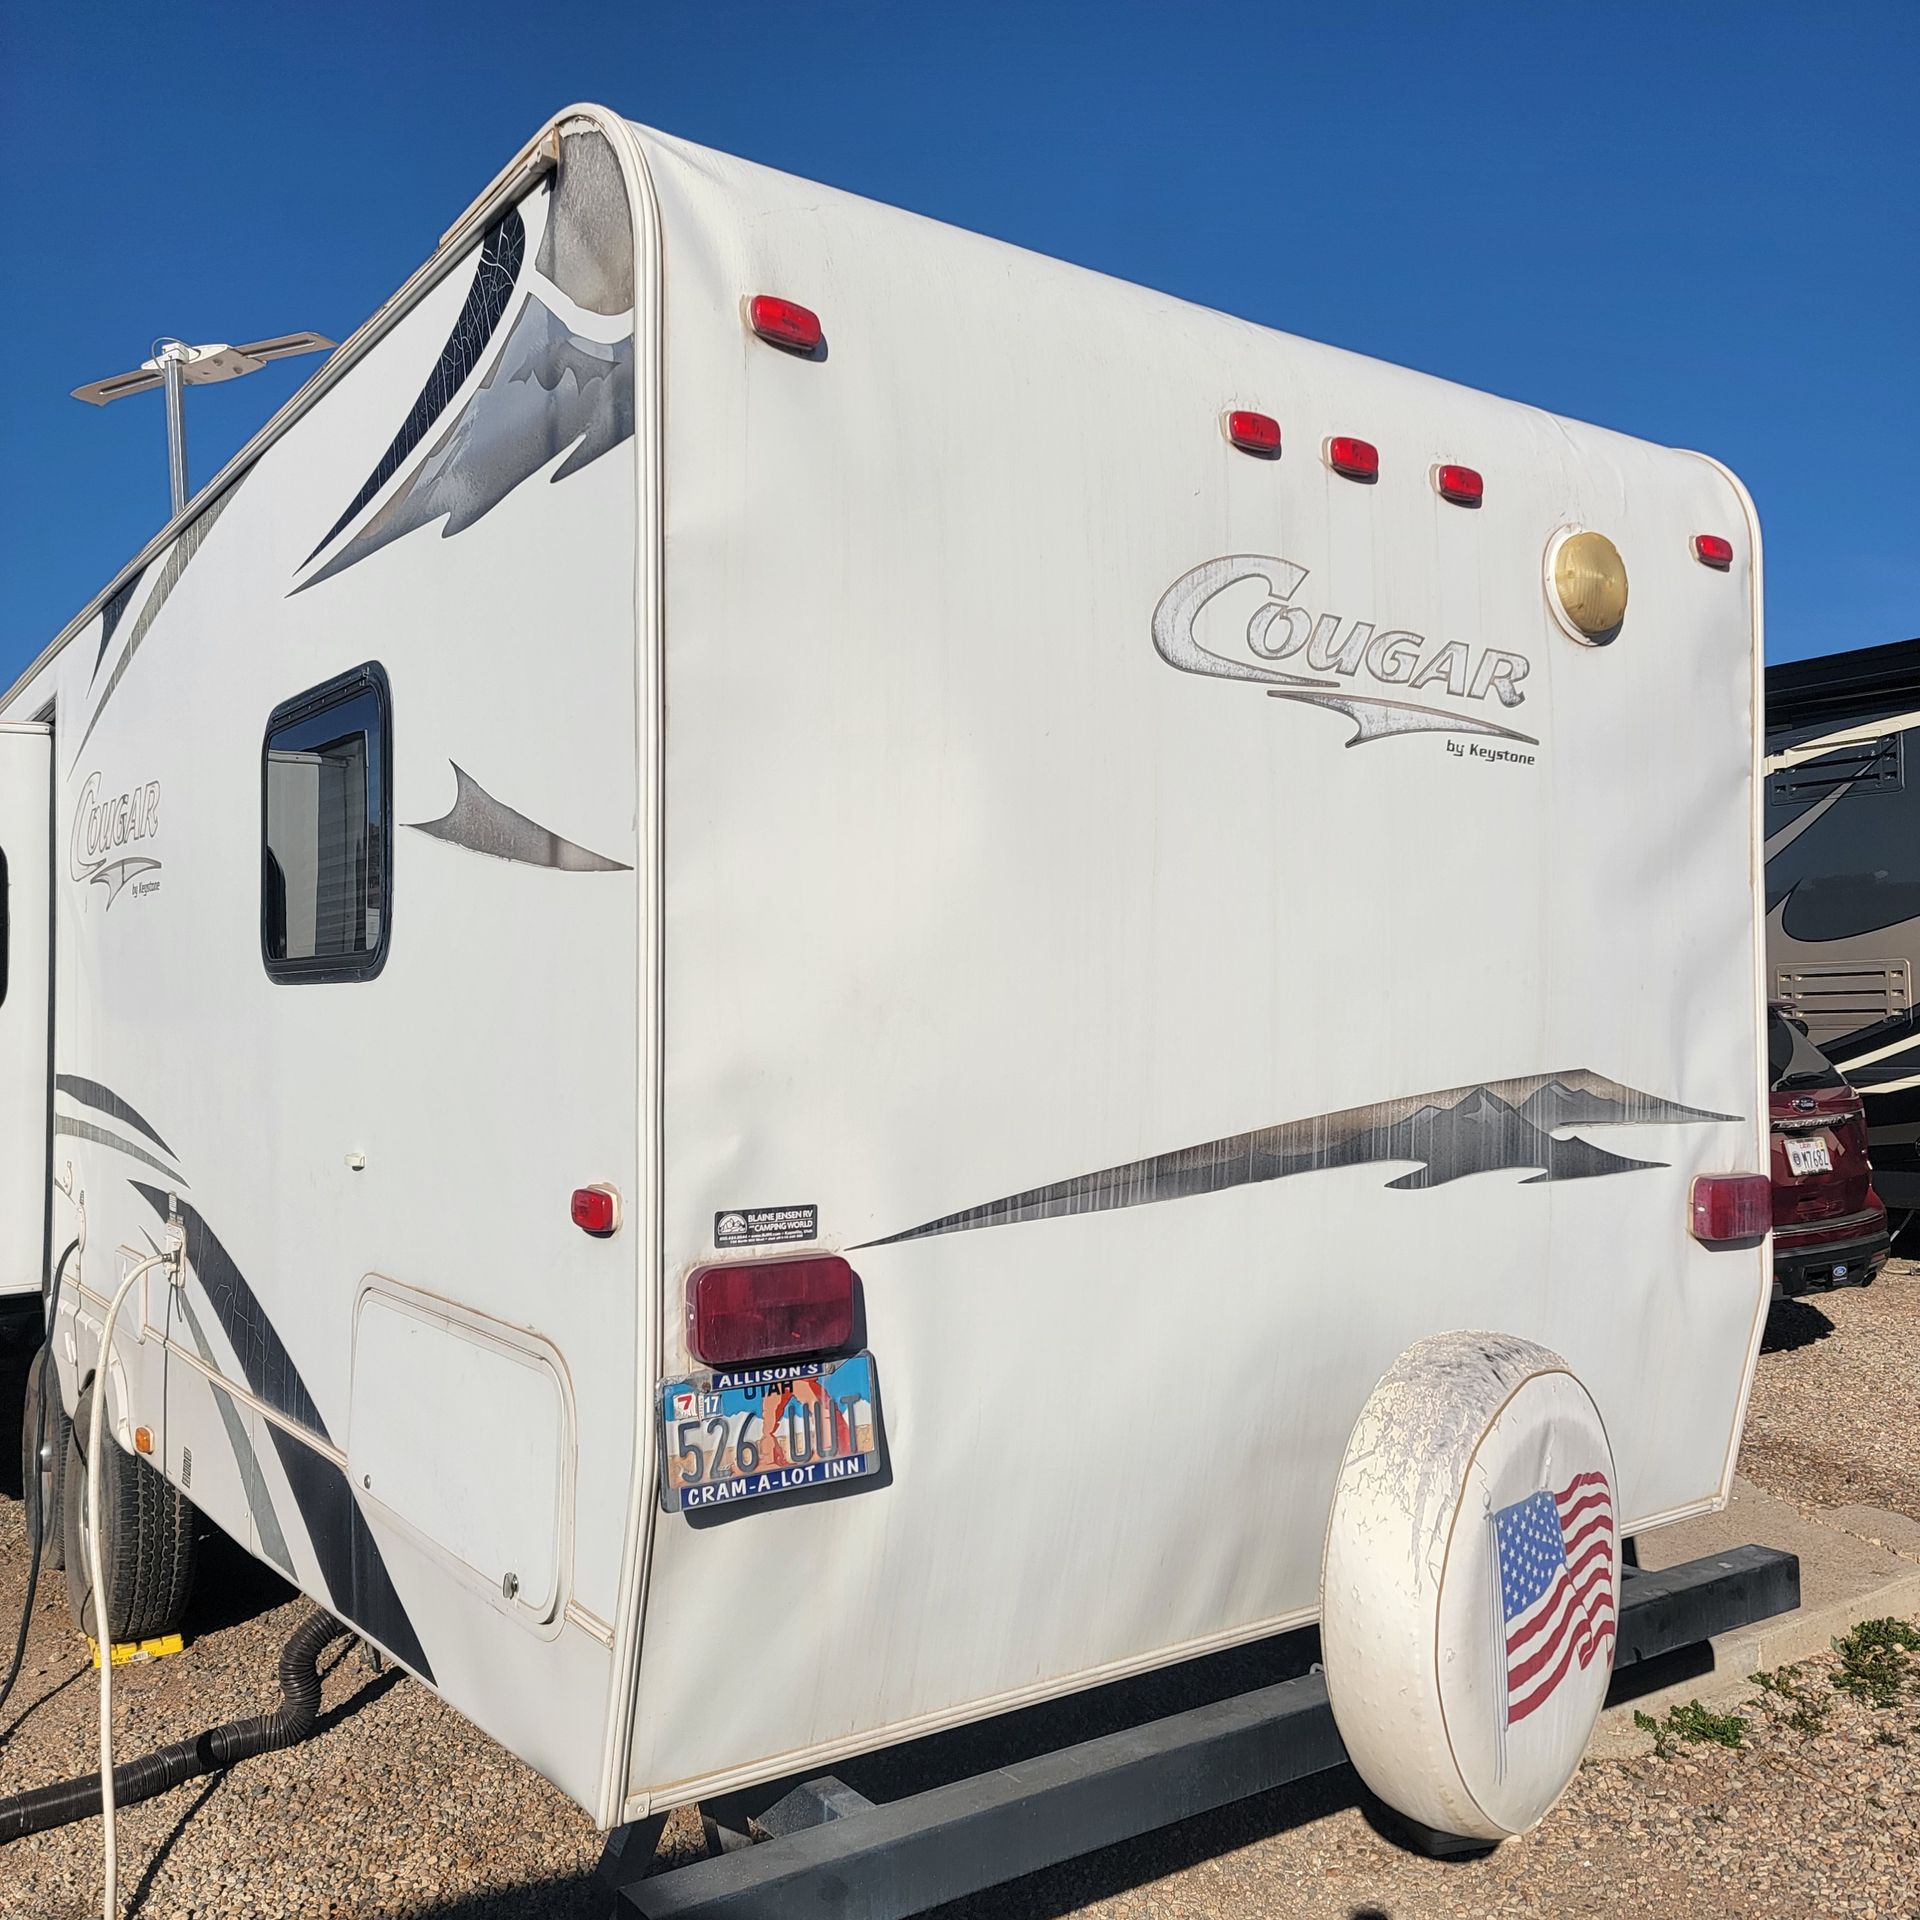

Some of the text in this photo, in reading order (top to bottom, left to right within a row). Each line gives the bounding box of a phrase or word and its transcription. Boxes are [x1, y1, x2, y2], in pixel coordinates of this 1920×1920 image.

[1151, 553, 1531, 708] COUGAR
[1446, 739, 1535, 766] by Keystone
[70, 771, 160, 883] COUGAR
[139, 881, 160, 897] Keystone
[748, 1209, 813, 1223] BLAINE JENSEN RV
[754, 1220, 813, 1232] CAMPING WORLD
[718, 1363, 818, 1388] ALLISON'S
[743, 1380, 793, 1400] UTAH
[677, 1394, 720, 1413] 7 17
[677, 1392, 862, 1484] 526 UUT
[687, 1457, 860, 1506] CRAM-A-LOT INN
